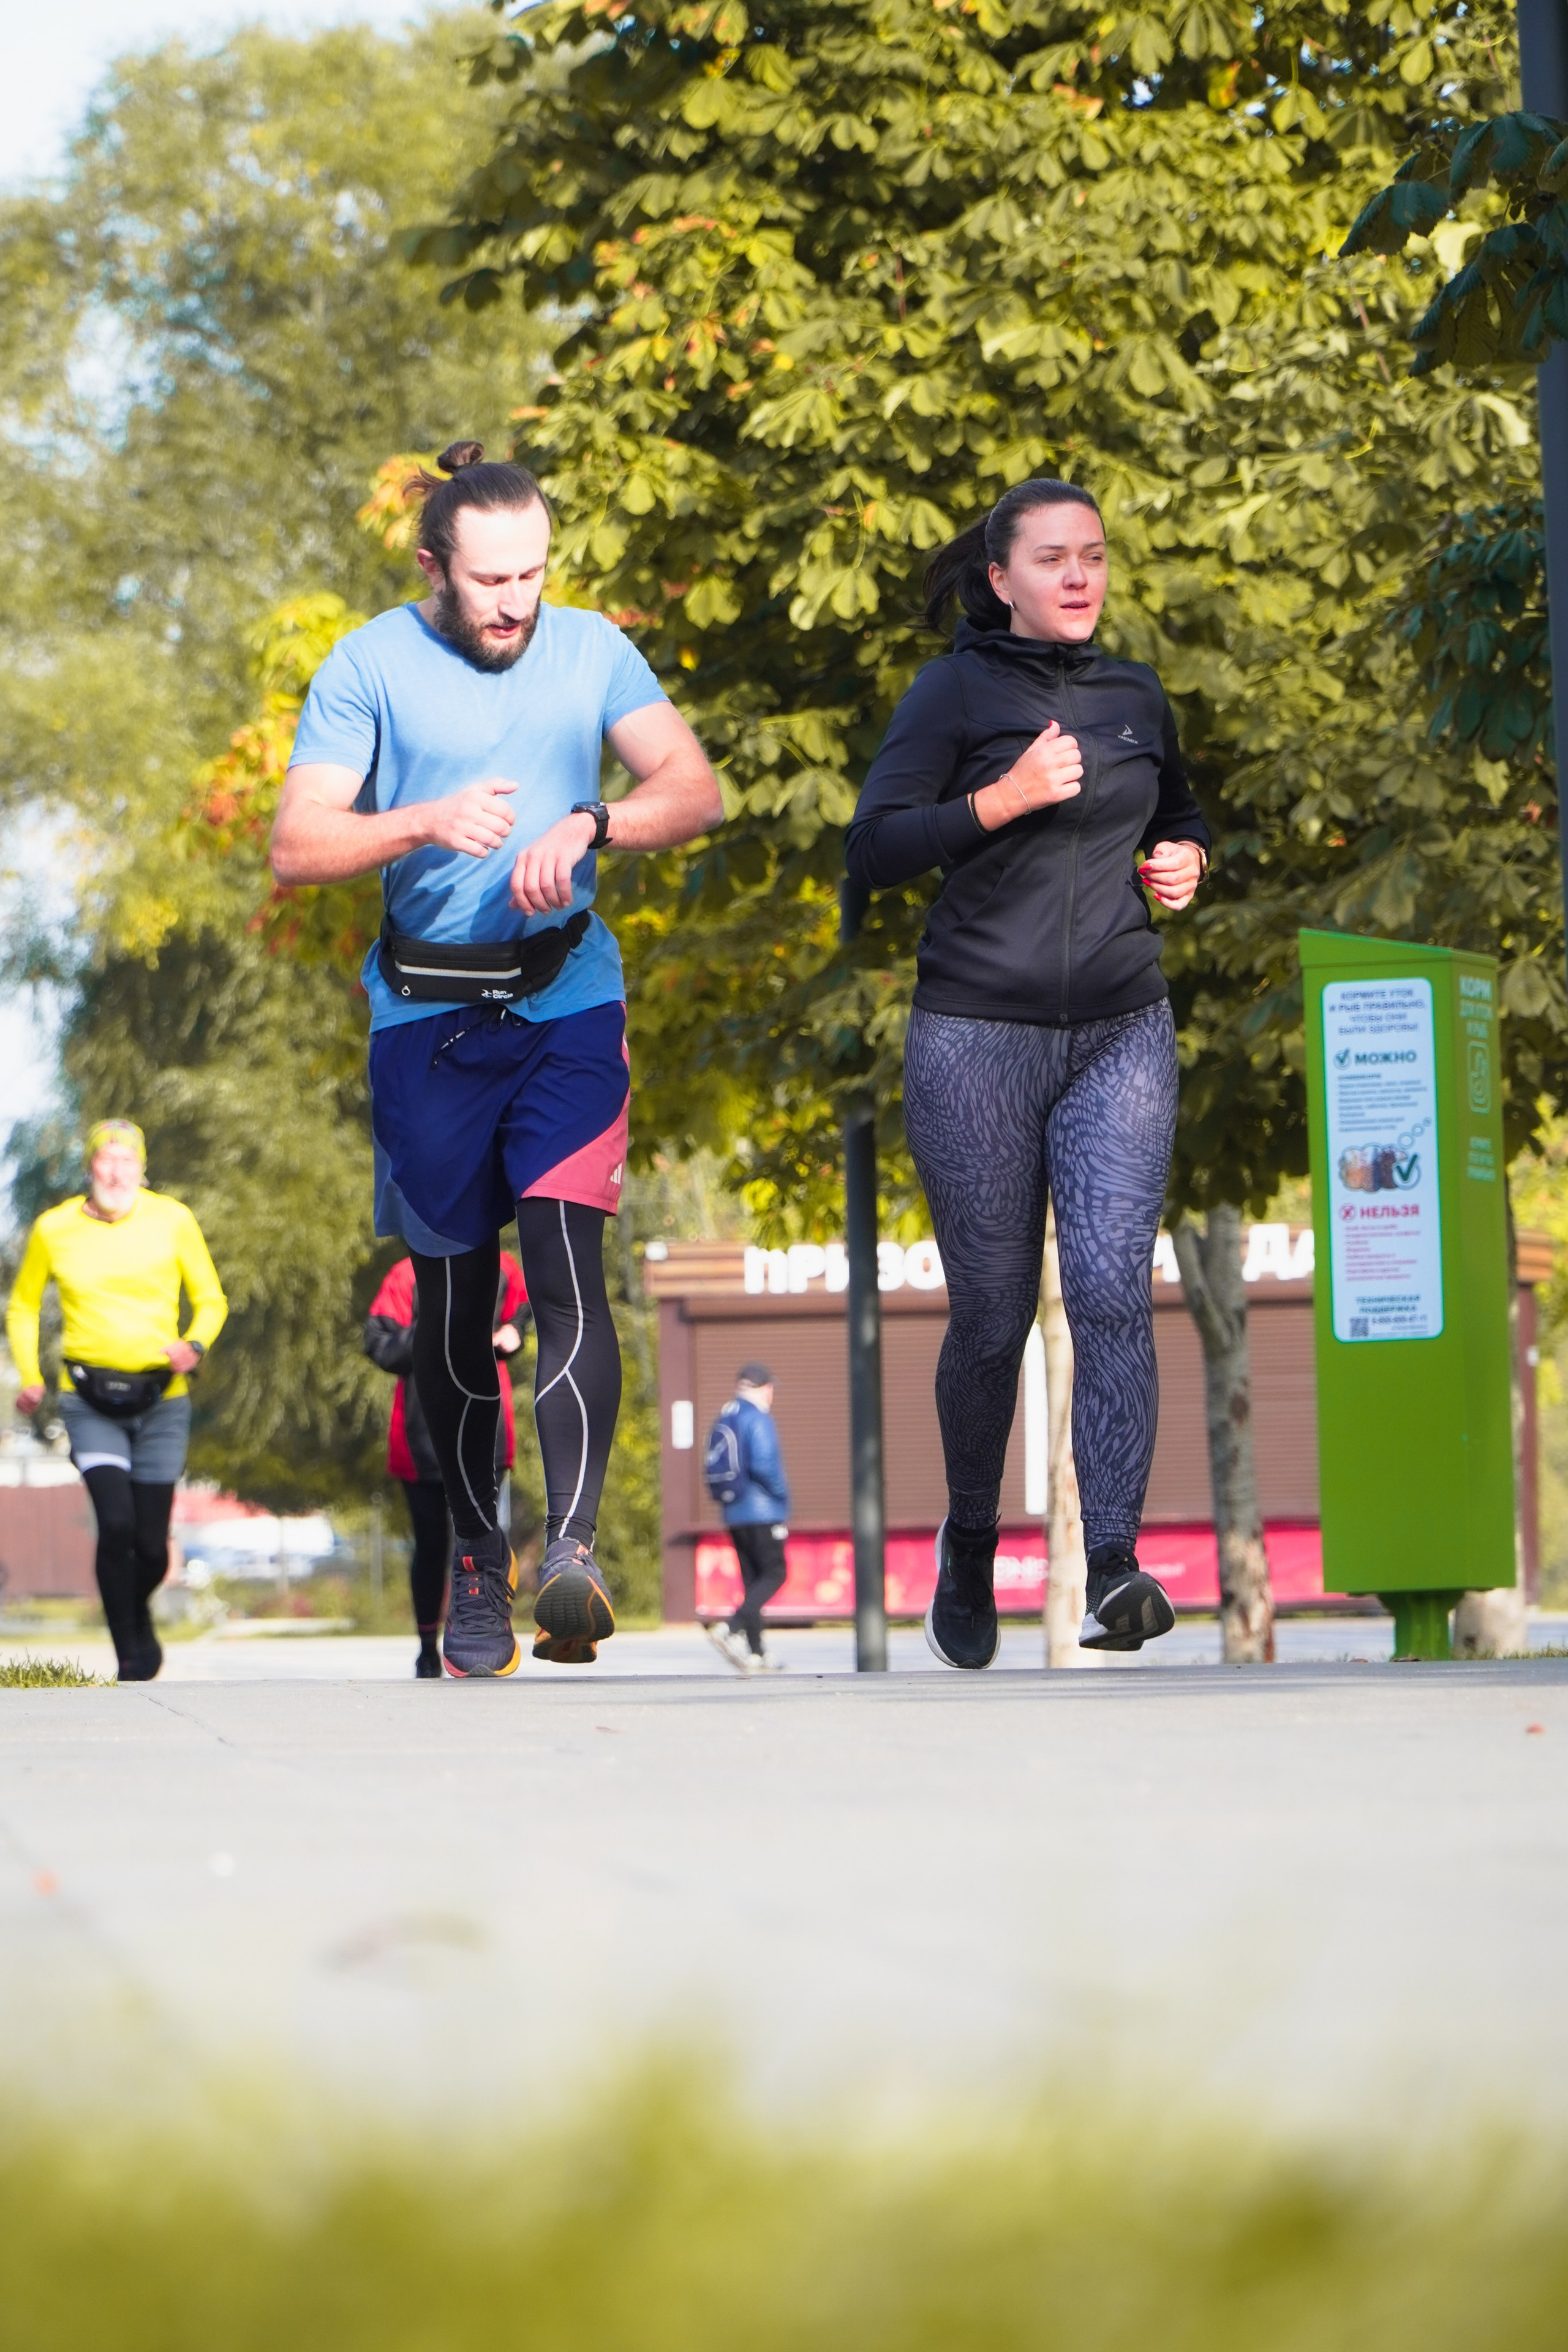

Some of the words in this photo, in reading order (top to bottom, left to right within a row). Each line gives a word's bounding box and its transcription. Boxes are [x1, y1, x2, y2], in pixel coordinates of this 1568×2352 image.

[1117, 735, 1139, 744] DEMIX
[1355, 1050, 1417, 1066] МОЖНО
[1360, 1204, 1420, 1219] НЕЛЬЗЯ
